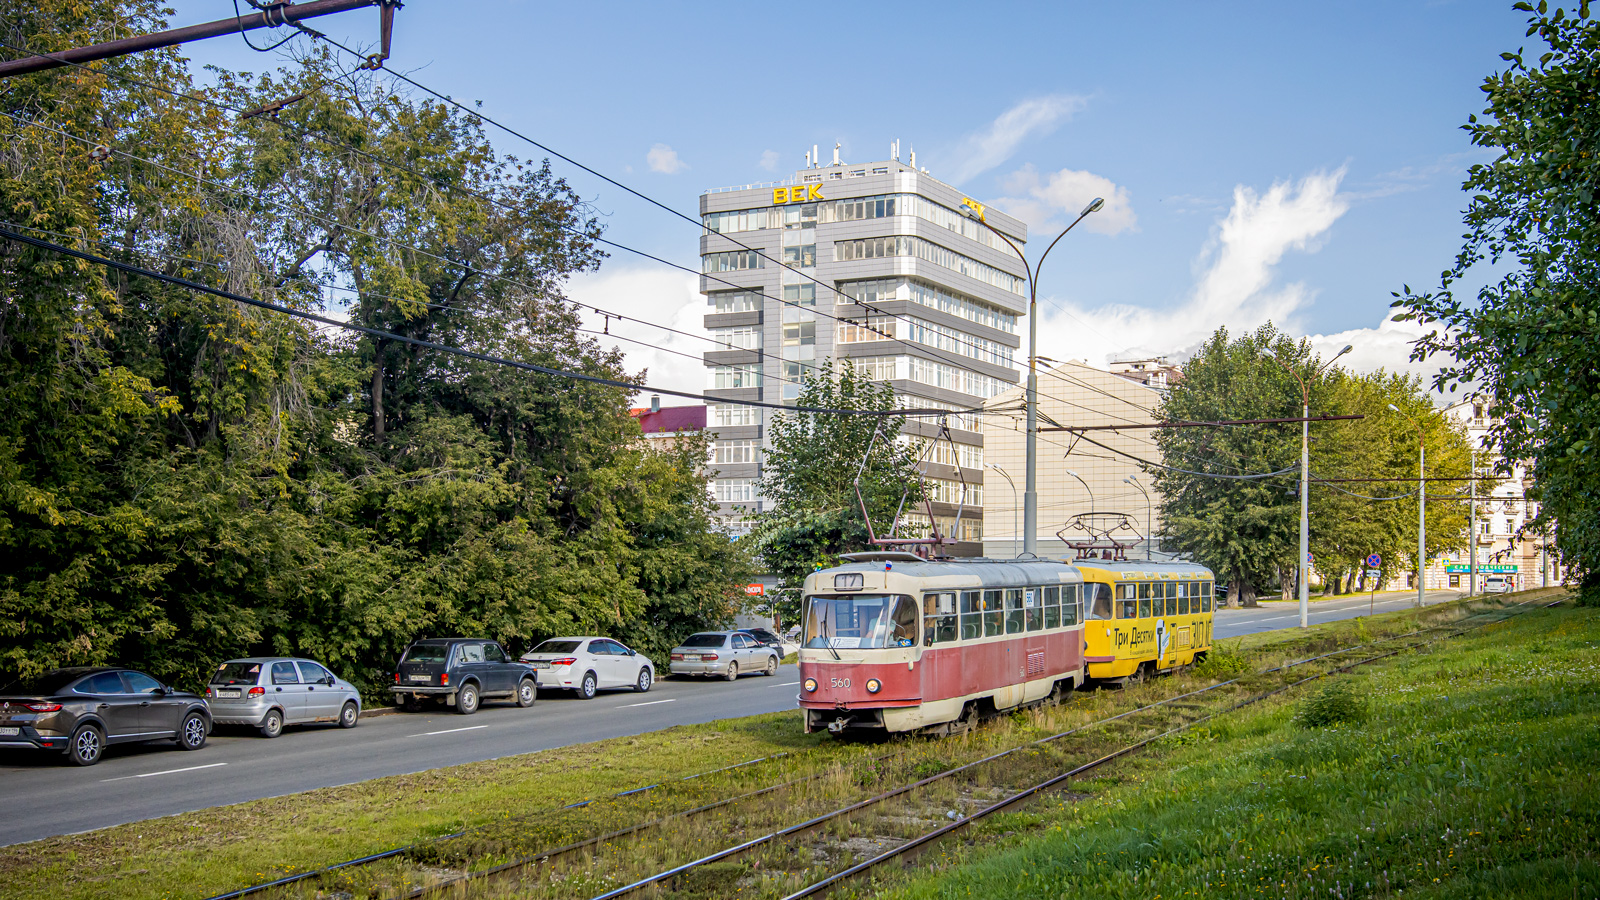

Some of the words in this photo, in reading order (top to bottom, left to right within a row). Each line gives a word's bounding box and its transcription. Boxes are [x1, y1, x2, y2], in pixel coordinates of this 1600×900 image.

[773, 183, 824, 205] ВЕК
[841, 575, 857, 589] 17
[1114, 628, 1129, 649] Три
[1130, 627, 1155, 649] Десятки
[831, 677, 851, 688] 560
